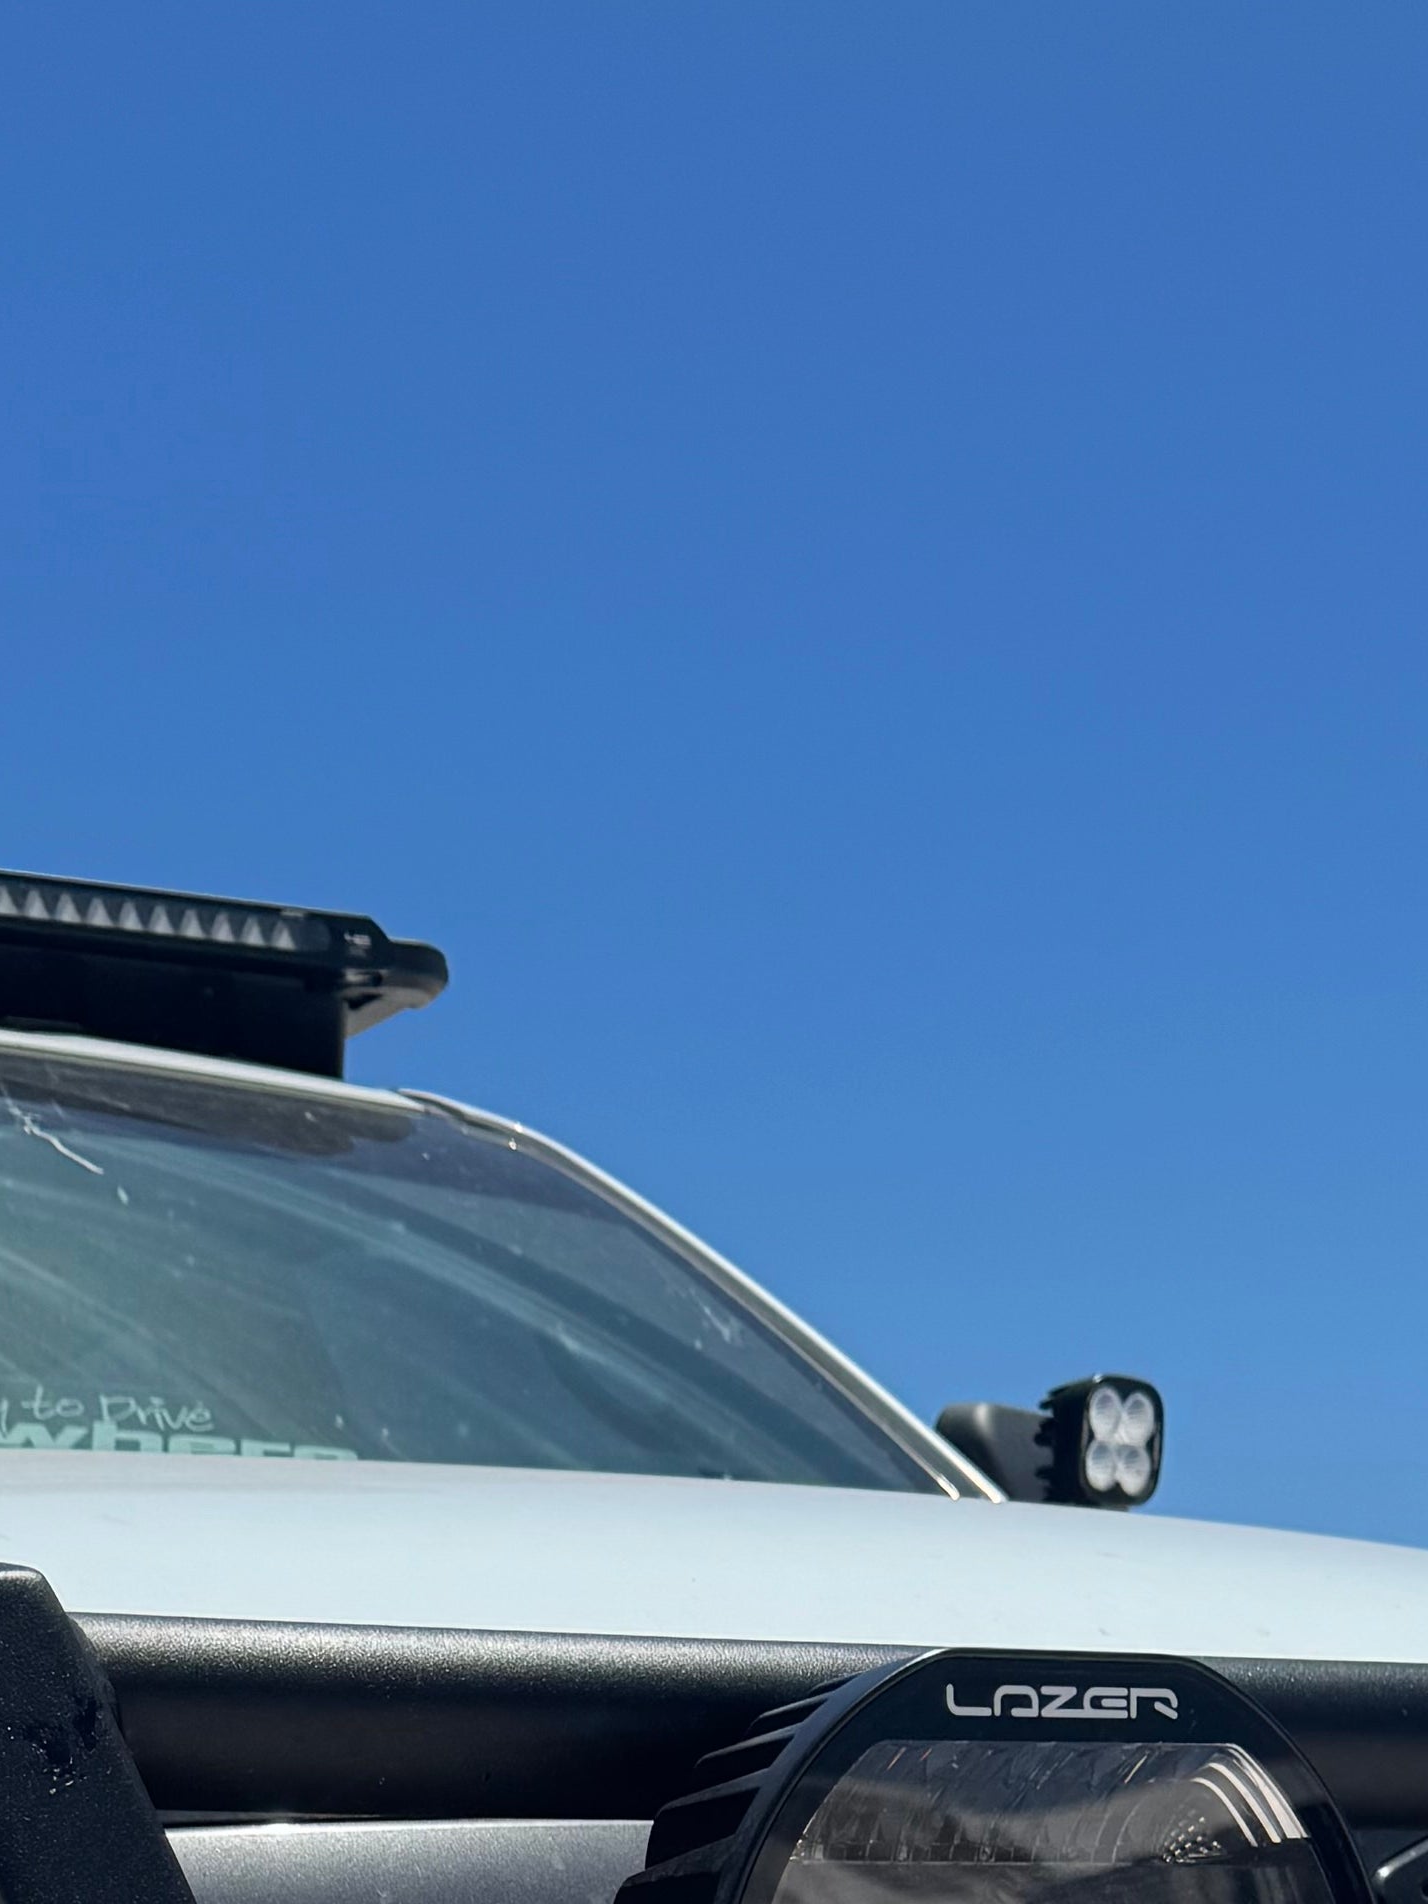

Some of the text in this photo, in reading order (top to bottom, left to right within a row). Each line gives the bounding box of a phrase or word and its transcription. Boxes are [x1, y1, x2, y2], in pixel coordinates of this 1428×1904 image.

[21, 1384, 85, 1420] to
[98, 1394, 214, 1432] Drive
[945, 1683, 1180, 1721] LAZER
